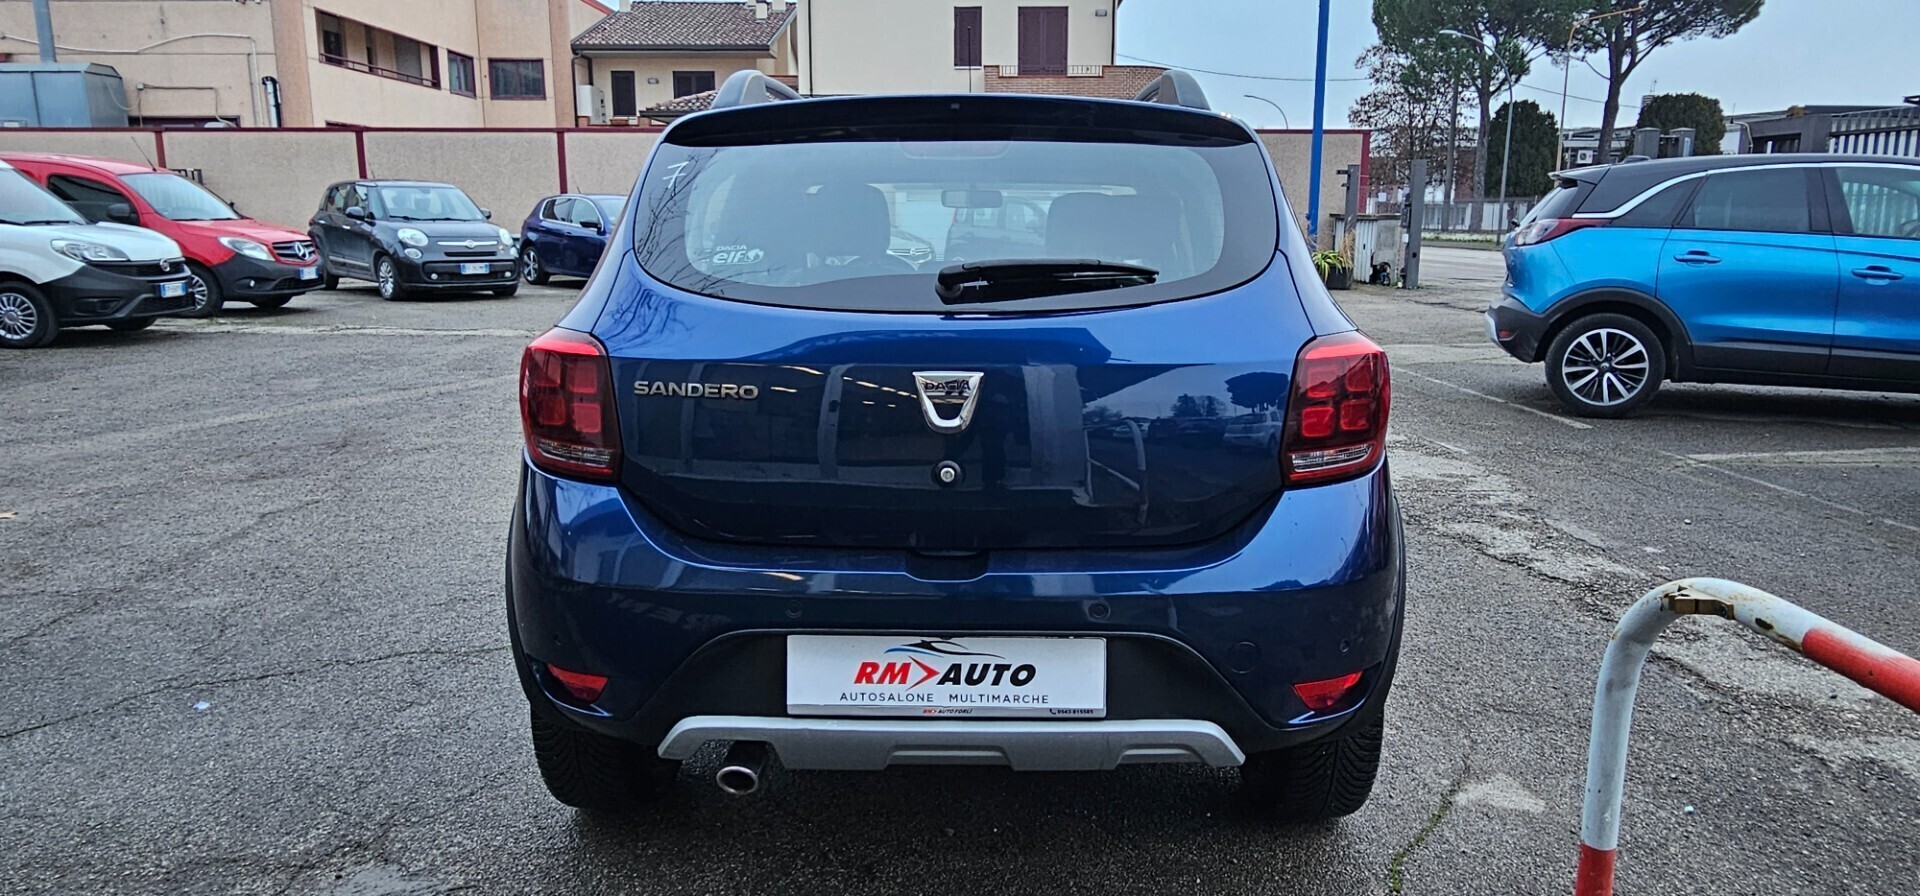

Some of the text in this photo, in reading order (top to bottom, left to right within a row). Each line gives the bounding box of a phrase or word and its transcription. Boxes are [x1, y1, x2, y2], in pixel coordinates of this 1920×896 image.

[662, 161, 690, 189] 7
[713, 251, 747, 264] elf
[634, 380, 759, 400] SANDERO
[925, 380, 972, 391] DACIA
[853, 661, 1036, 686] RM AUTO
[839, 692, 1050, 704] AUTOSALONE MULTIMARCHE
